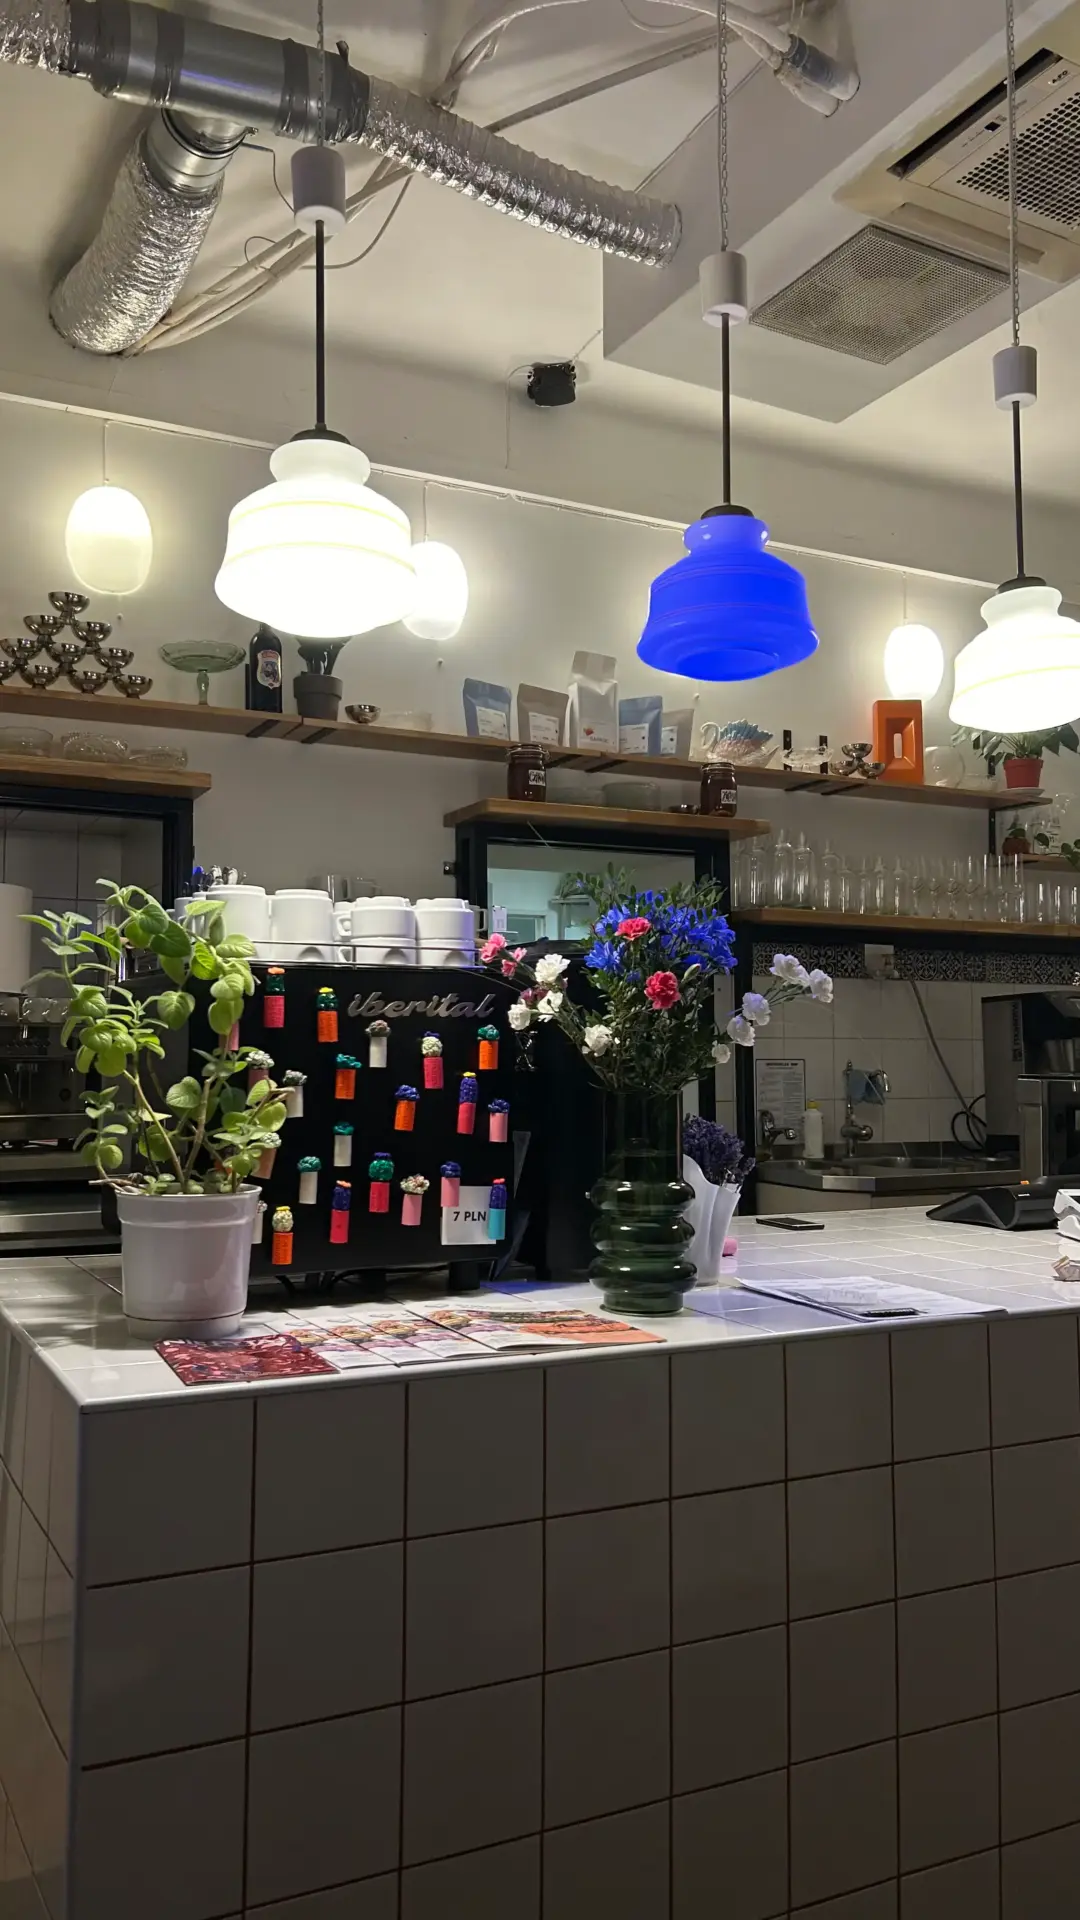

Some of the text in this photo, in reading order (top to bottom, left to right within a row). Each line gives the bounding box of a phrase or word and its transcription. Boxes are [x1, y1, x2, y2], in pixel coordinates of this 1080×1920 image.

[348, 991, 496, 1018] iberital
[453, 1211, 487, 1222] 7 PLN
